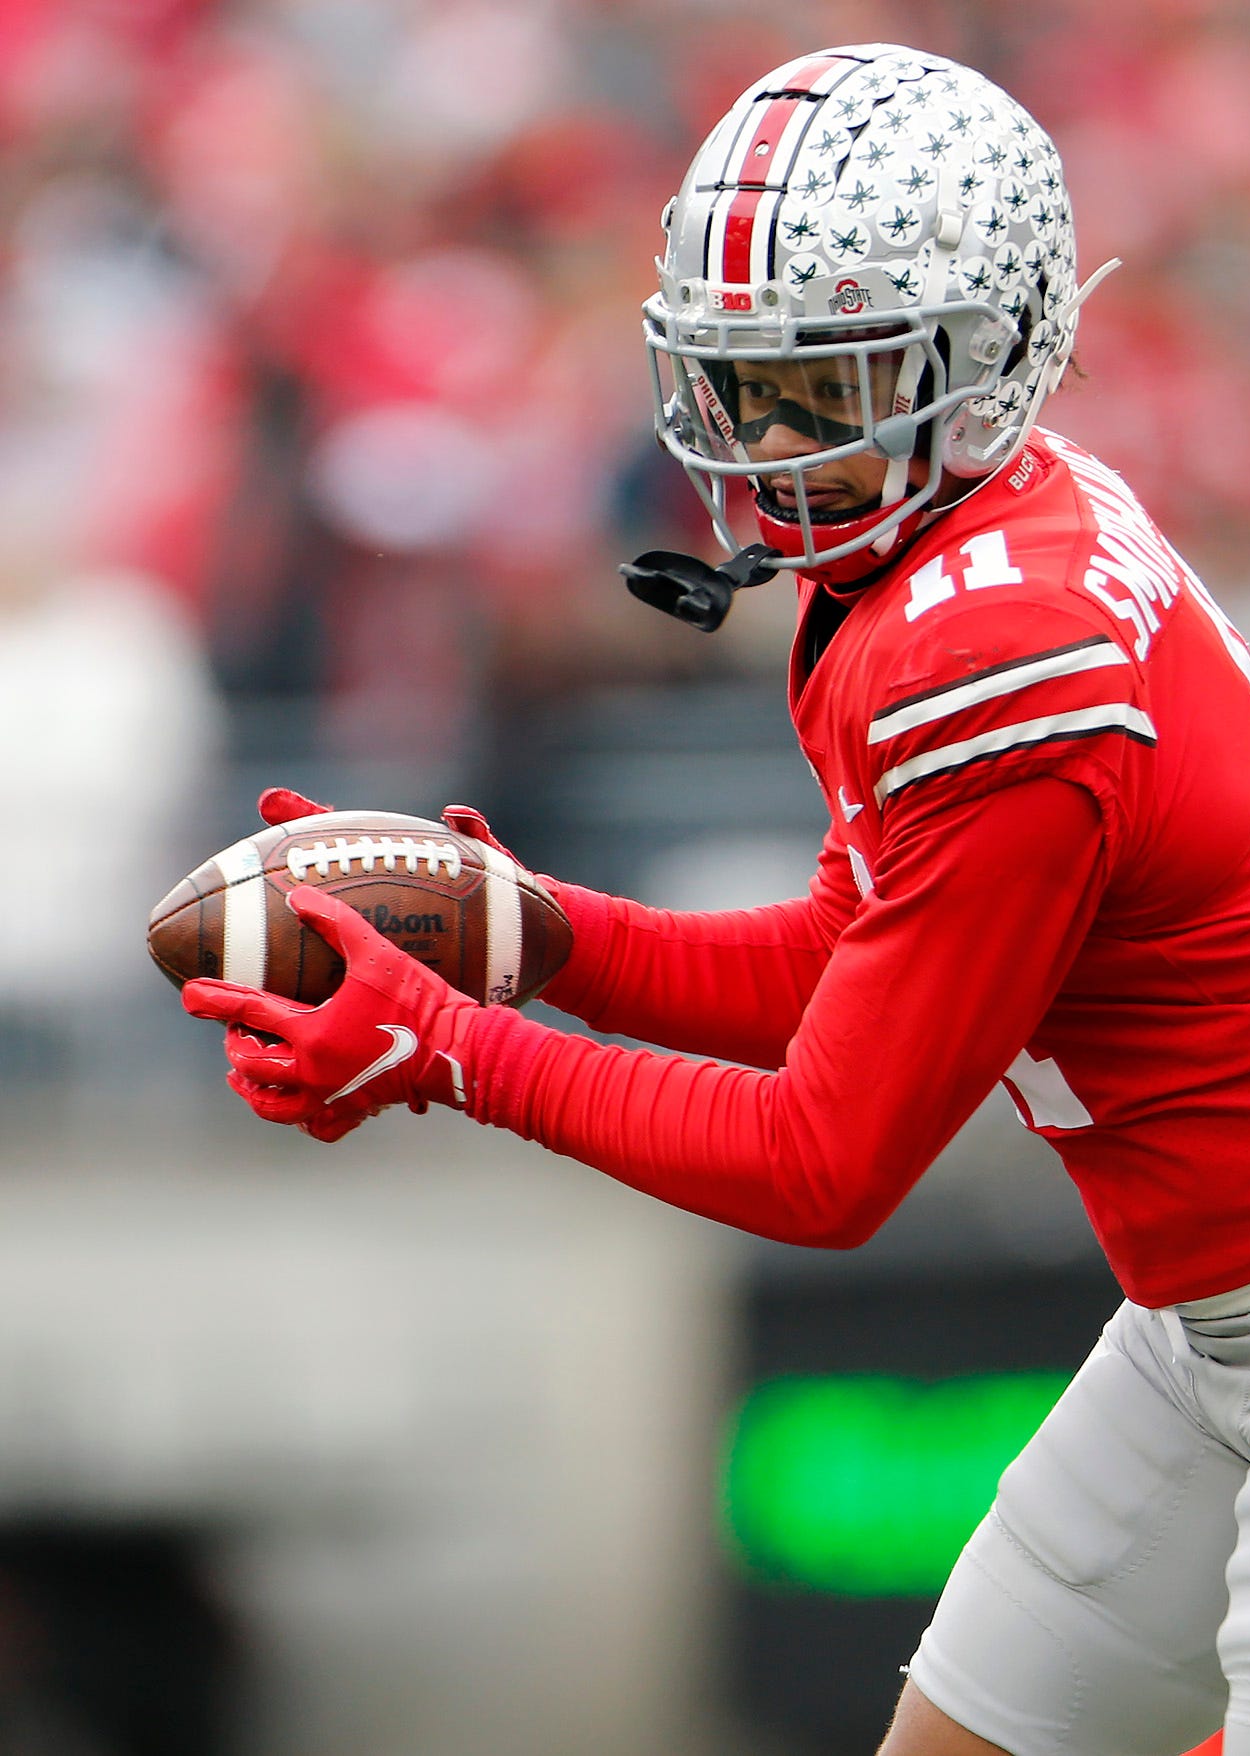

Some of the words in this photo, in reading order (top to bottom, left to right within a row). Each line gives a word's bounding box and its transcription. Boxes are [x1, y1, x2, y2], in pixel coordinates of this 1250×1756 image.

[845, 288, 874, 308] STATE
[698, 375, 717, 408] OHIO
[904, 529, 1024, 623] 11
